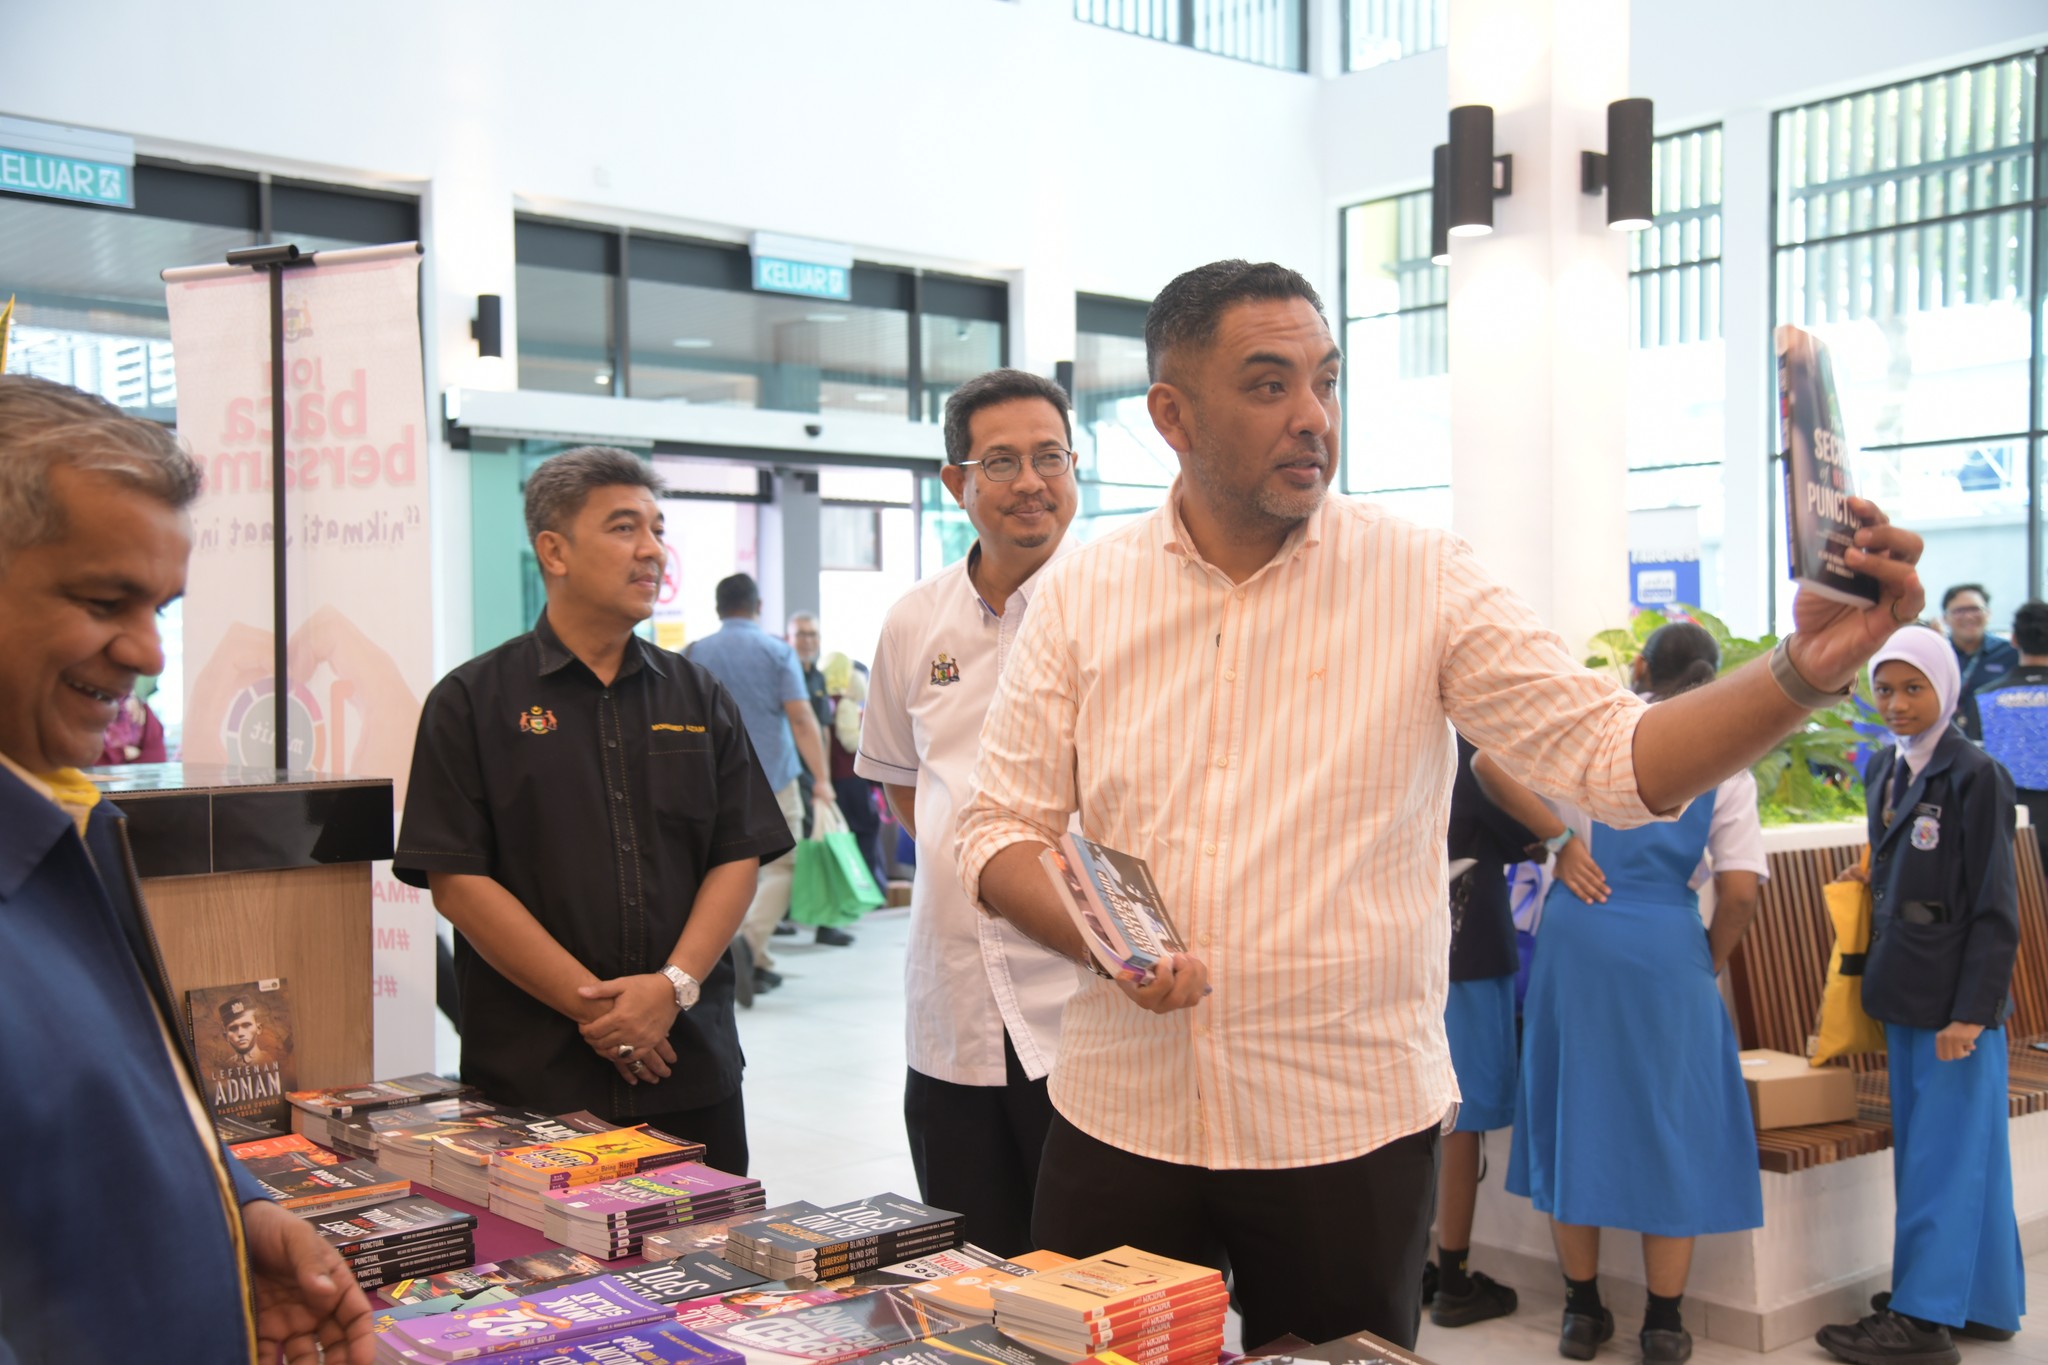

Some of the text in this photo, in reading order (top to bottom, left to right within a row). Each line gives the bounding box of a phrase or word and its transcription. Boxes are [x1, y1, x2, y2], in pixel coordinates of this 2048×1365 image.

[0, 154, 94, 196] ELUAR
[759, 259, 830, 292] KELUAR
[211, 1061, 280, 1081] LEFTENAN
[214, 1071, 282, 1107] ADNAN
[792, 1214, 871, 1238] BLIND
[824, 1205, 912, 1231] SPOT
[360, 1239, 385, 1251] PUNCTUAL
[866, 1235, 879, 1246] SPOT
[354, 1254, 379, 1266] PUNCTUAL
[866, 1247, 878, 1258] SPOT
[866, 1256, 879, 1268] SPOT
[357, 1266, 382, 1279] PUNCTUAL
[626, 1265, 711, 1296] SPOT
